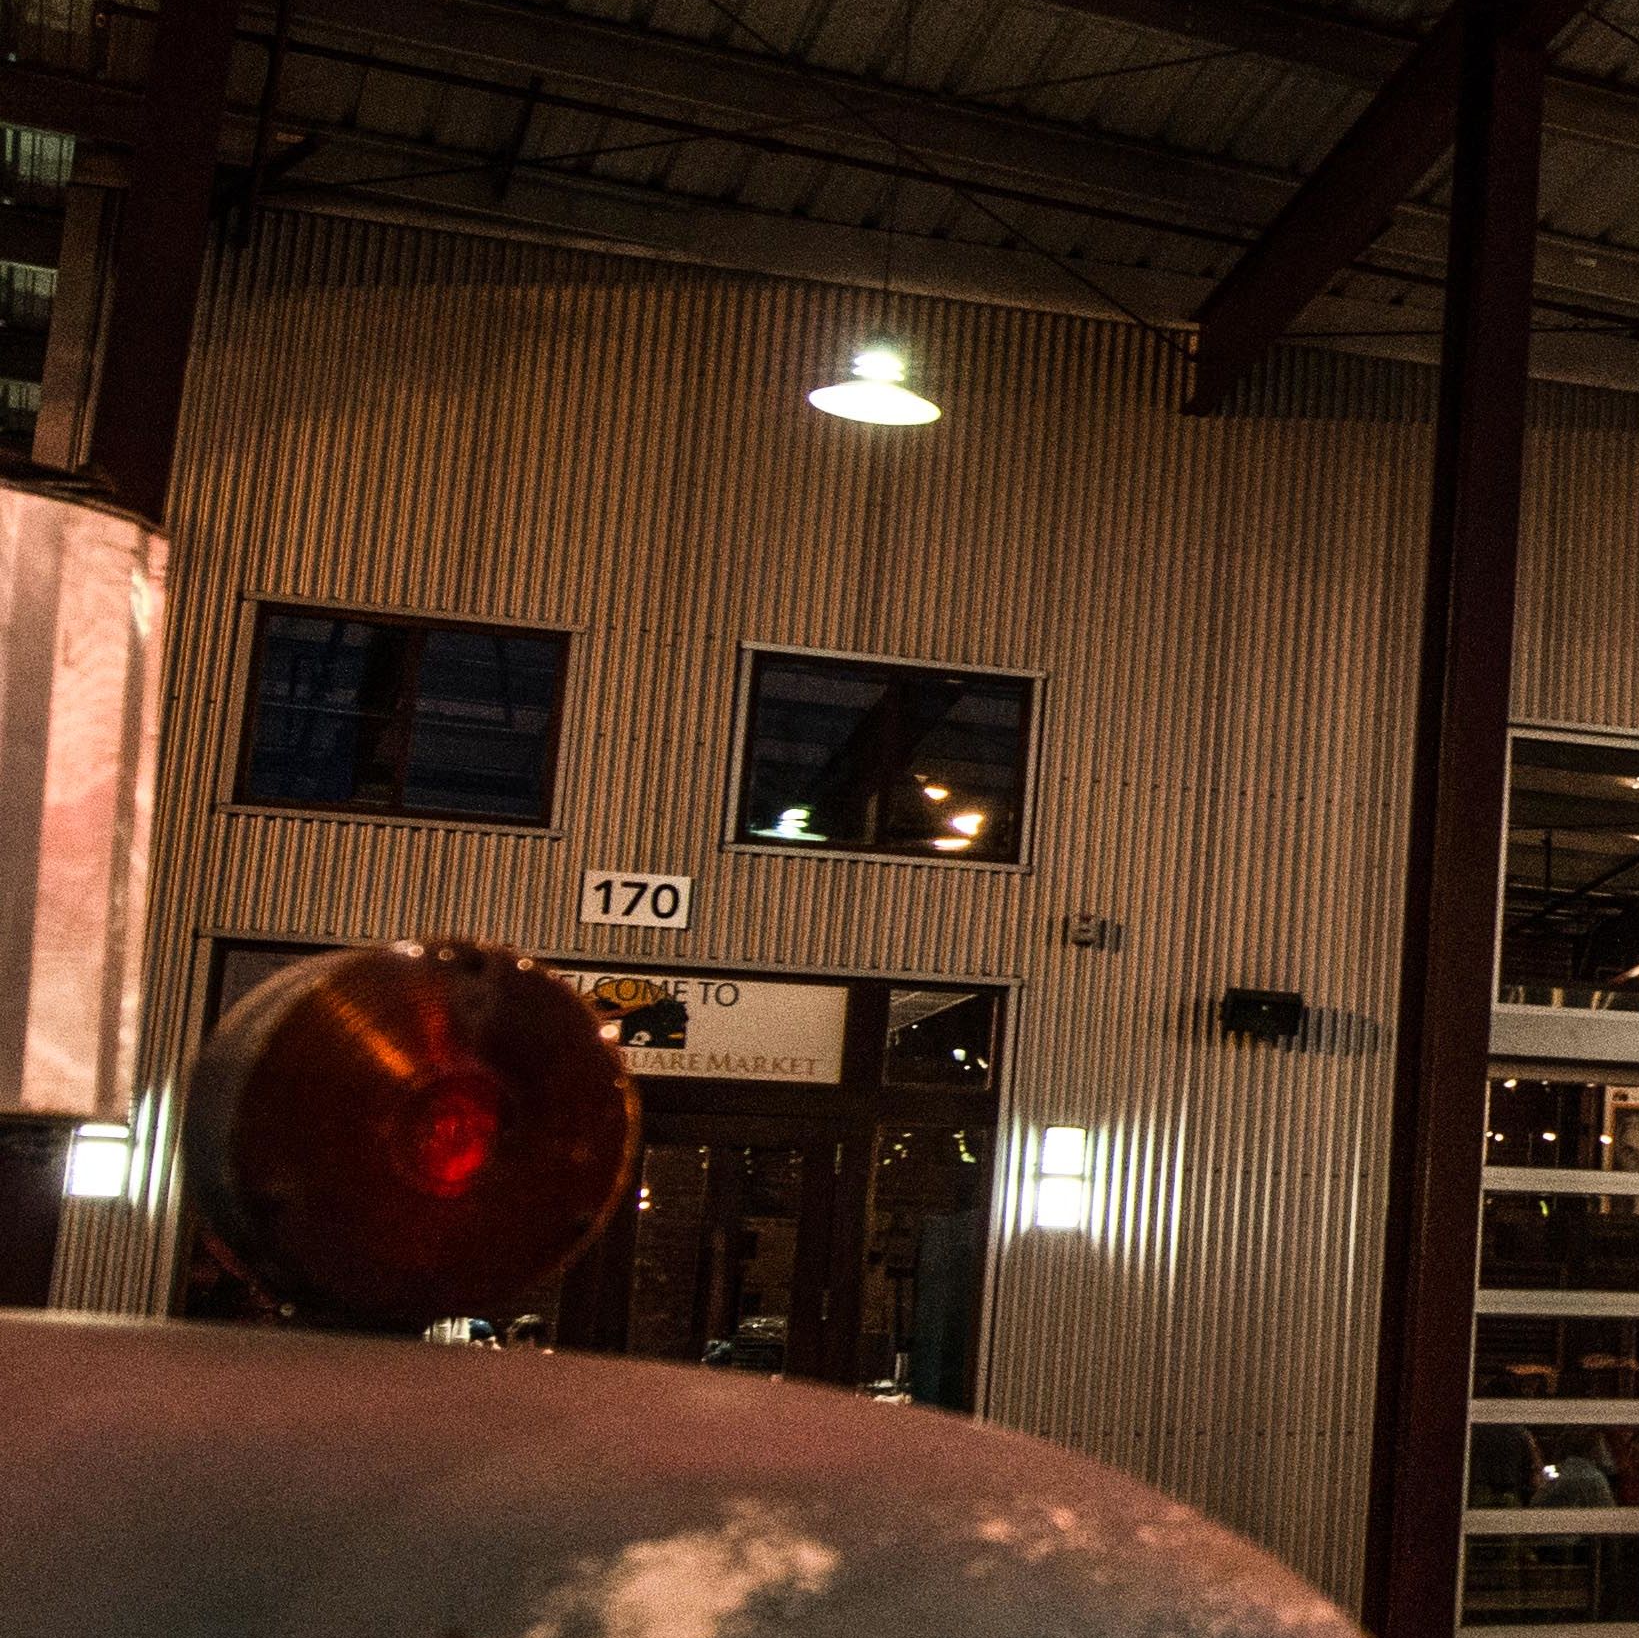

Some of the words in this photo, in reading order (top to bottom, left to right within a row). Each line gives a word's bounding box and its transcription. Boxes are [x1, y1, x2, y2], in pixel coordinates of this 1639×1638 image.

[594, 878, 680, 920] 170
[699, 981, 741, 1008] TO
[704, 1051, 823, 1076] MARKET
